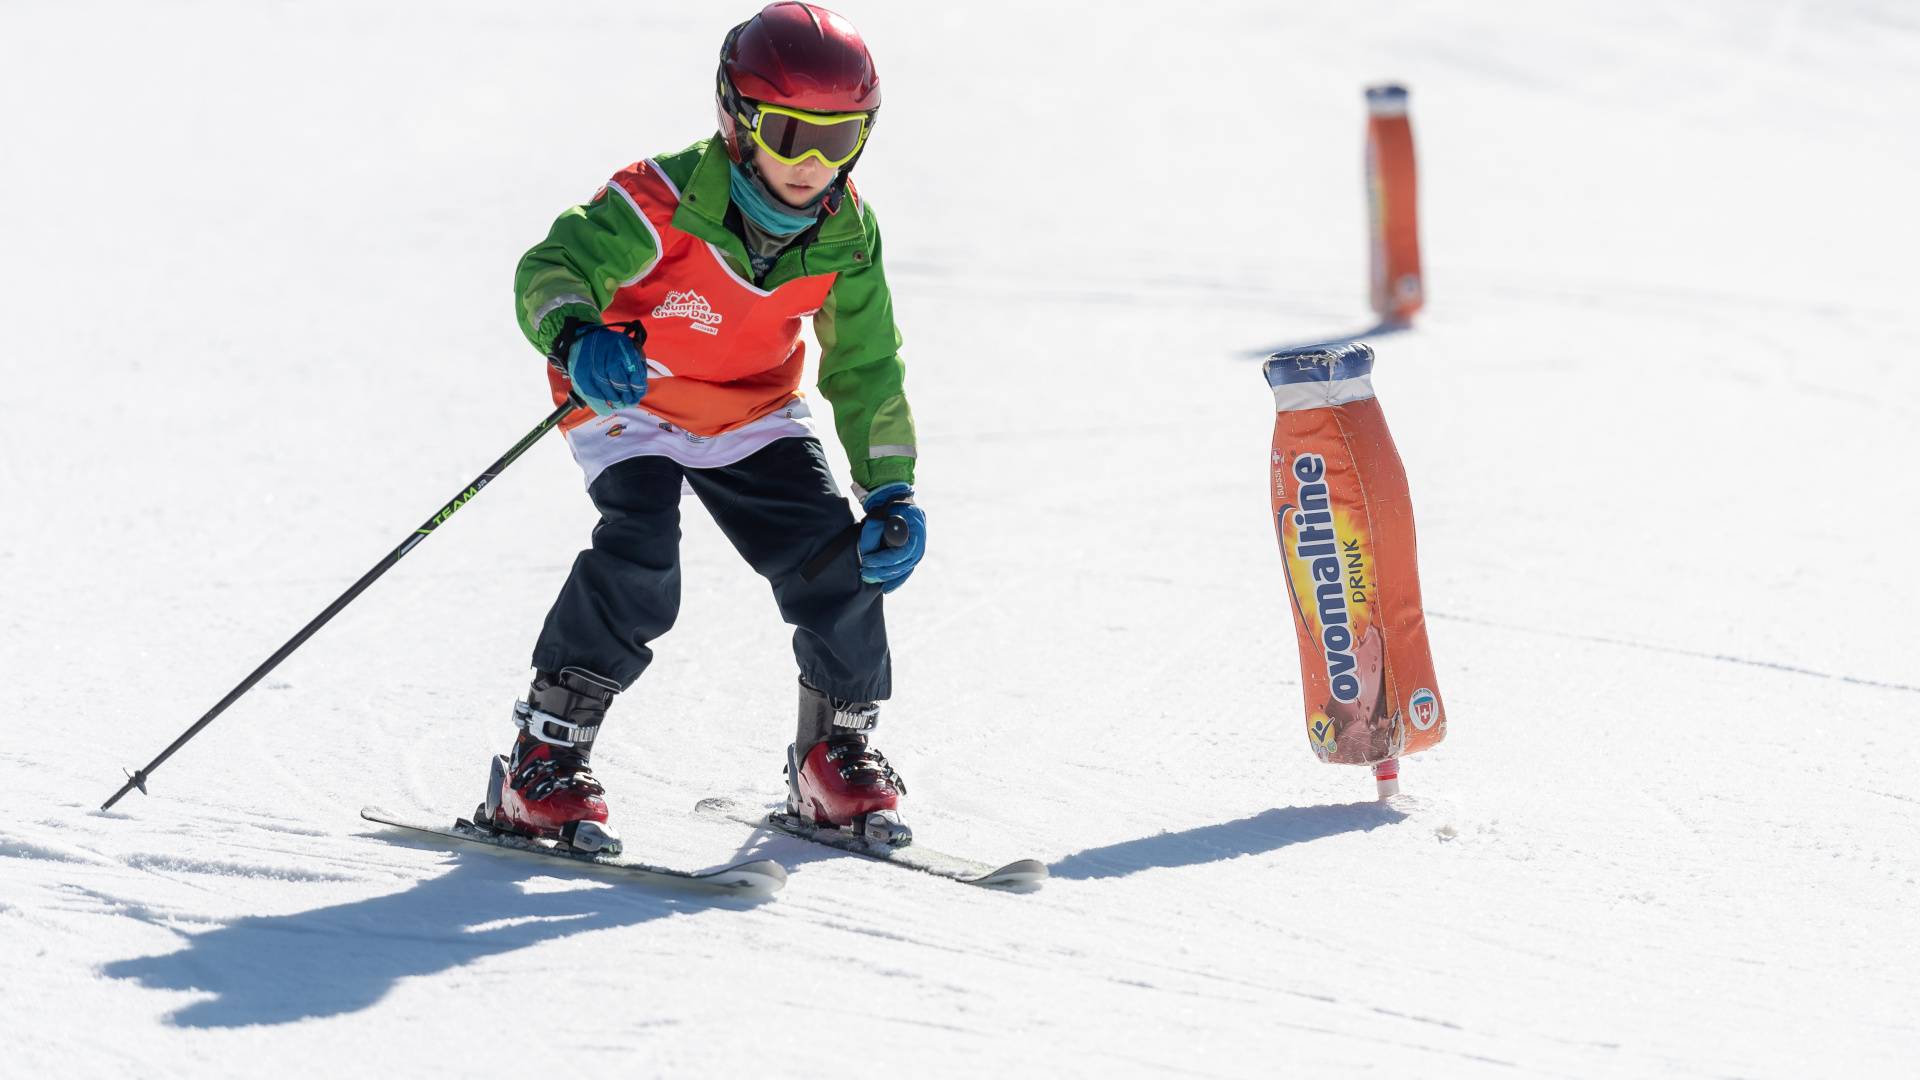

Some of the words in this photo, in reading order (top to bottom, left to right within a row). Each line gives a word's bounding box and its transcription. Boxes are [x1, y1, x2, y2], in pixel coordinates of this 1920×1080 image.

[664, 301, 709, 312] Sunrise
[691, 310, 720, 322] Days
[433, 486, 478, 525] TEAM
[1294, 455, 1359, 701] ovomaltine
[1343, 538, 1367, 604] DRINK
